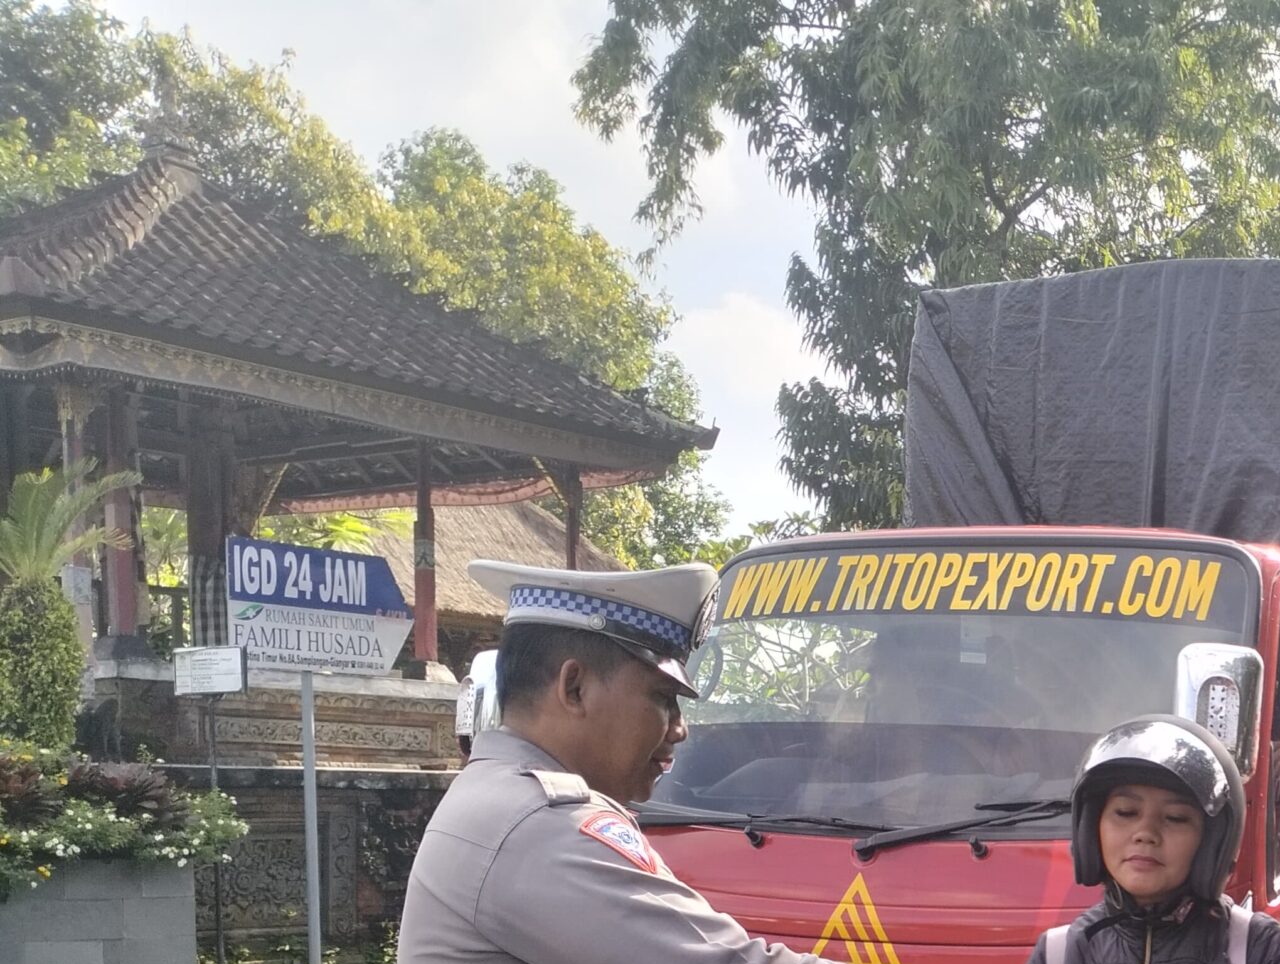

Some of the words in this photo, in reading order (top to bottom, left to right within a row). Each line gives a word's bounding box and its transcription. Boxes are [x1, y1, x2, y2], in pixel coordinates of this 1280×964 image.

[233, 545, 278, 596] IGD
[284, 551, 313, 600] 24
[319, 557, 367, 606] JAM
[722, 552, 1222, 621] WWW.TRITOPEXPORT.COM
[234, 623, 302, 651] FAMILI
[307, 631, 383, 658] HUSADA
[265, 608, 306, 625] RUMAH
[309, 613, 341, 629] SAKIT
[342, 618, 375, 633] UMUM
